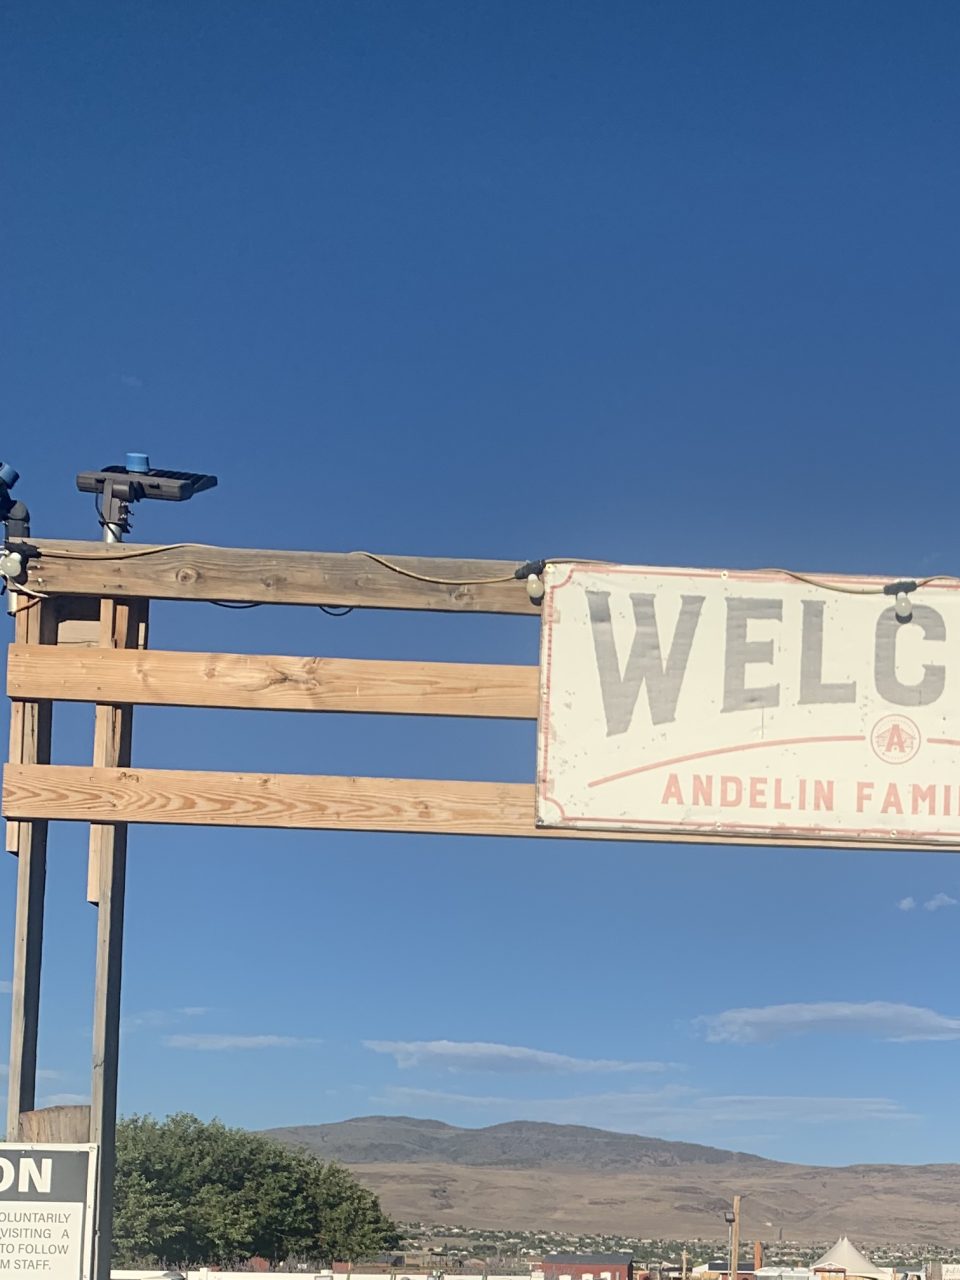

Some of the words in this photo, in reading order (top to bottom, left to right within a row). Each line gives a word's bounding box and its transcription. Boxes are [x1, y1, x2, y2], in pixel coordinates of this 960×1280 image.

[661, 772, 834, 812] ANDELIN
[0, 1227, 52, 1239] VISITING
[61, 1228, 70, 1239] A
[0, 1243, 15, 1254] TO
[18, 1243, 69, 1255] FOLLOW
[14, 1259, 52, 1271] STAFF.
